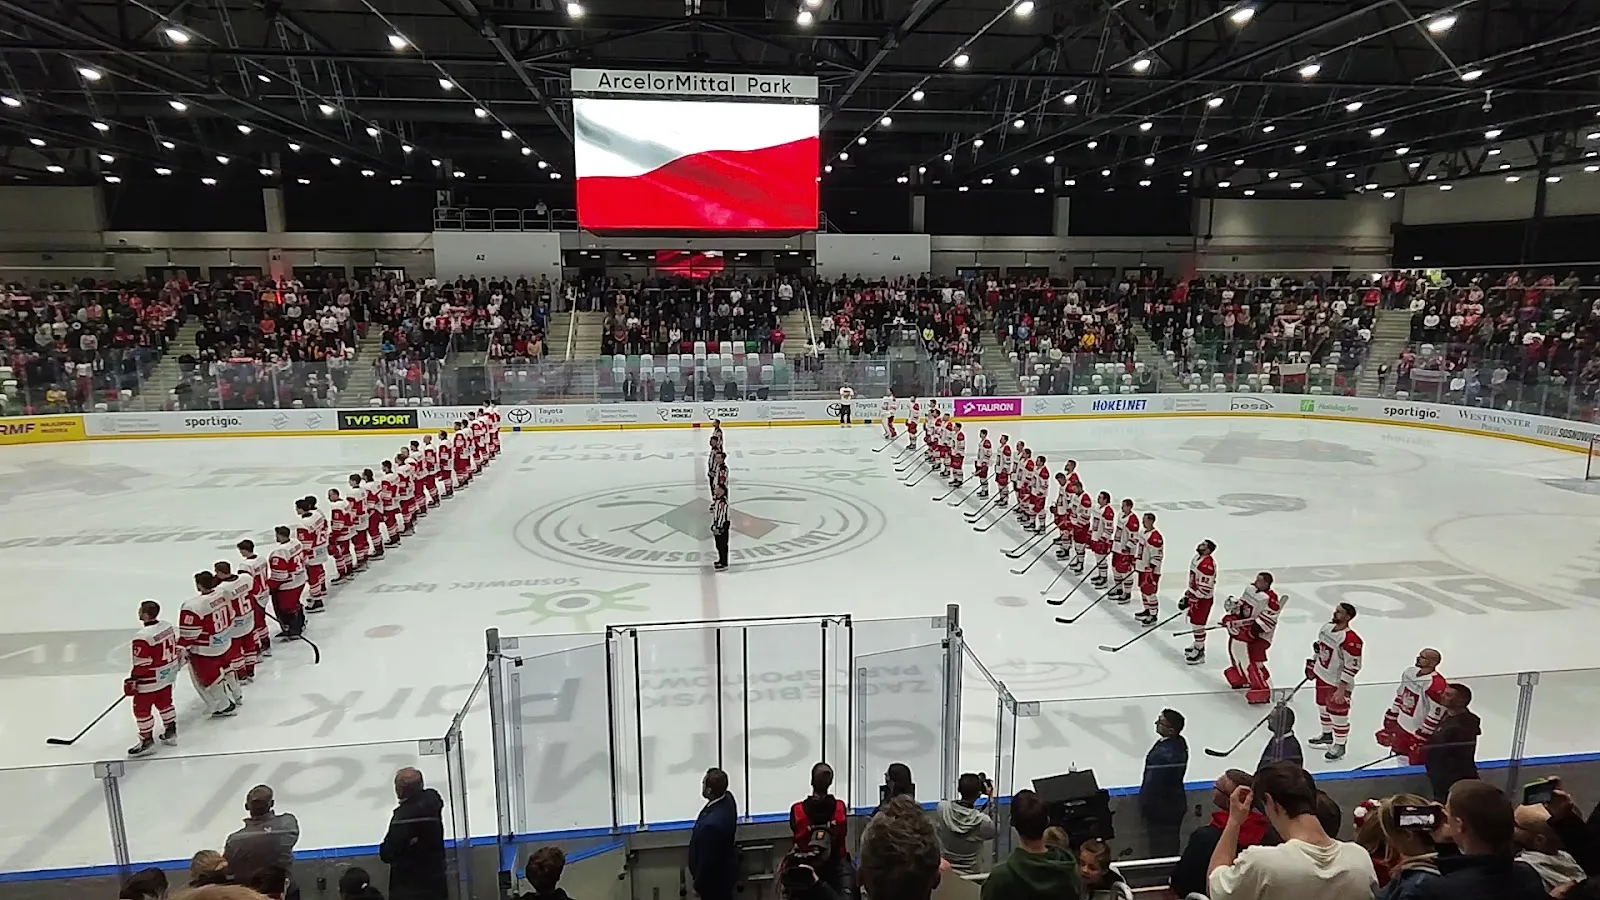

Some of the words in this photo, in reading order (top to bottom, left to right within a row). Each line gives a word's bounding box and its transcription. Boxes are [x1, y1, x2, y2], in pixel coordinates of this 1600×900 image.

[597, 72, 736, 93] ArcelorMittal
[747, 77, 792, 94] Park
[976, 402, 1014, 412] TAURON
[1091, 399, 1147, 411] HOKEJ.NET
[1230, 402, 1270, 411] pesa
[345, 415, 370, 426] TVP
[372, 414, 411, 425] SPORT
[0, 422, 35, 435] RMF
[449, 576, 582, 592] Sosnowiec
[212, 607, 229, 633] 80
